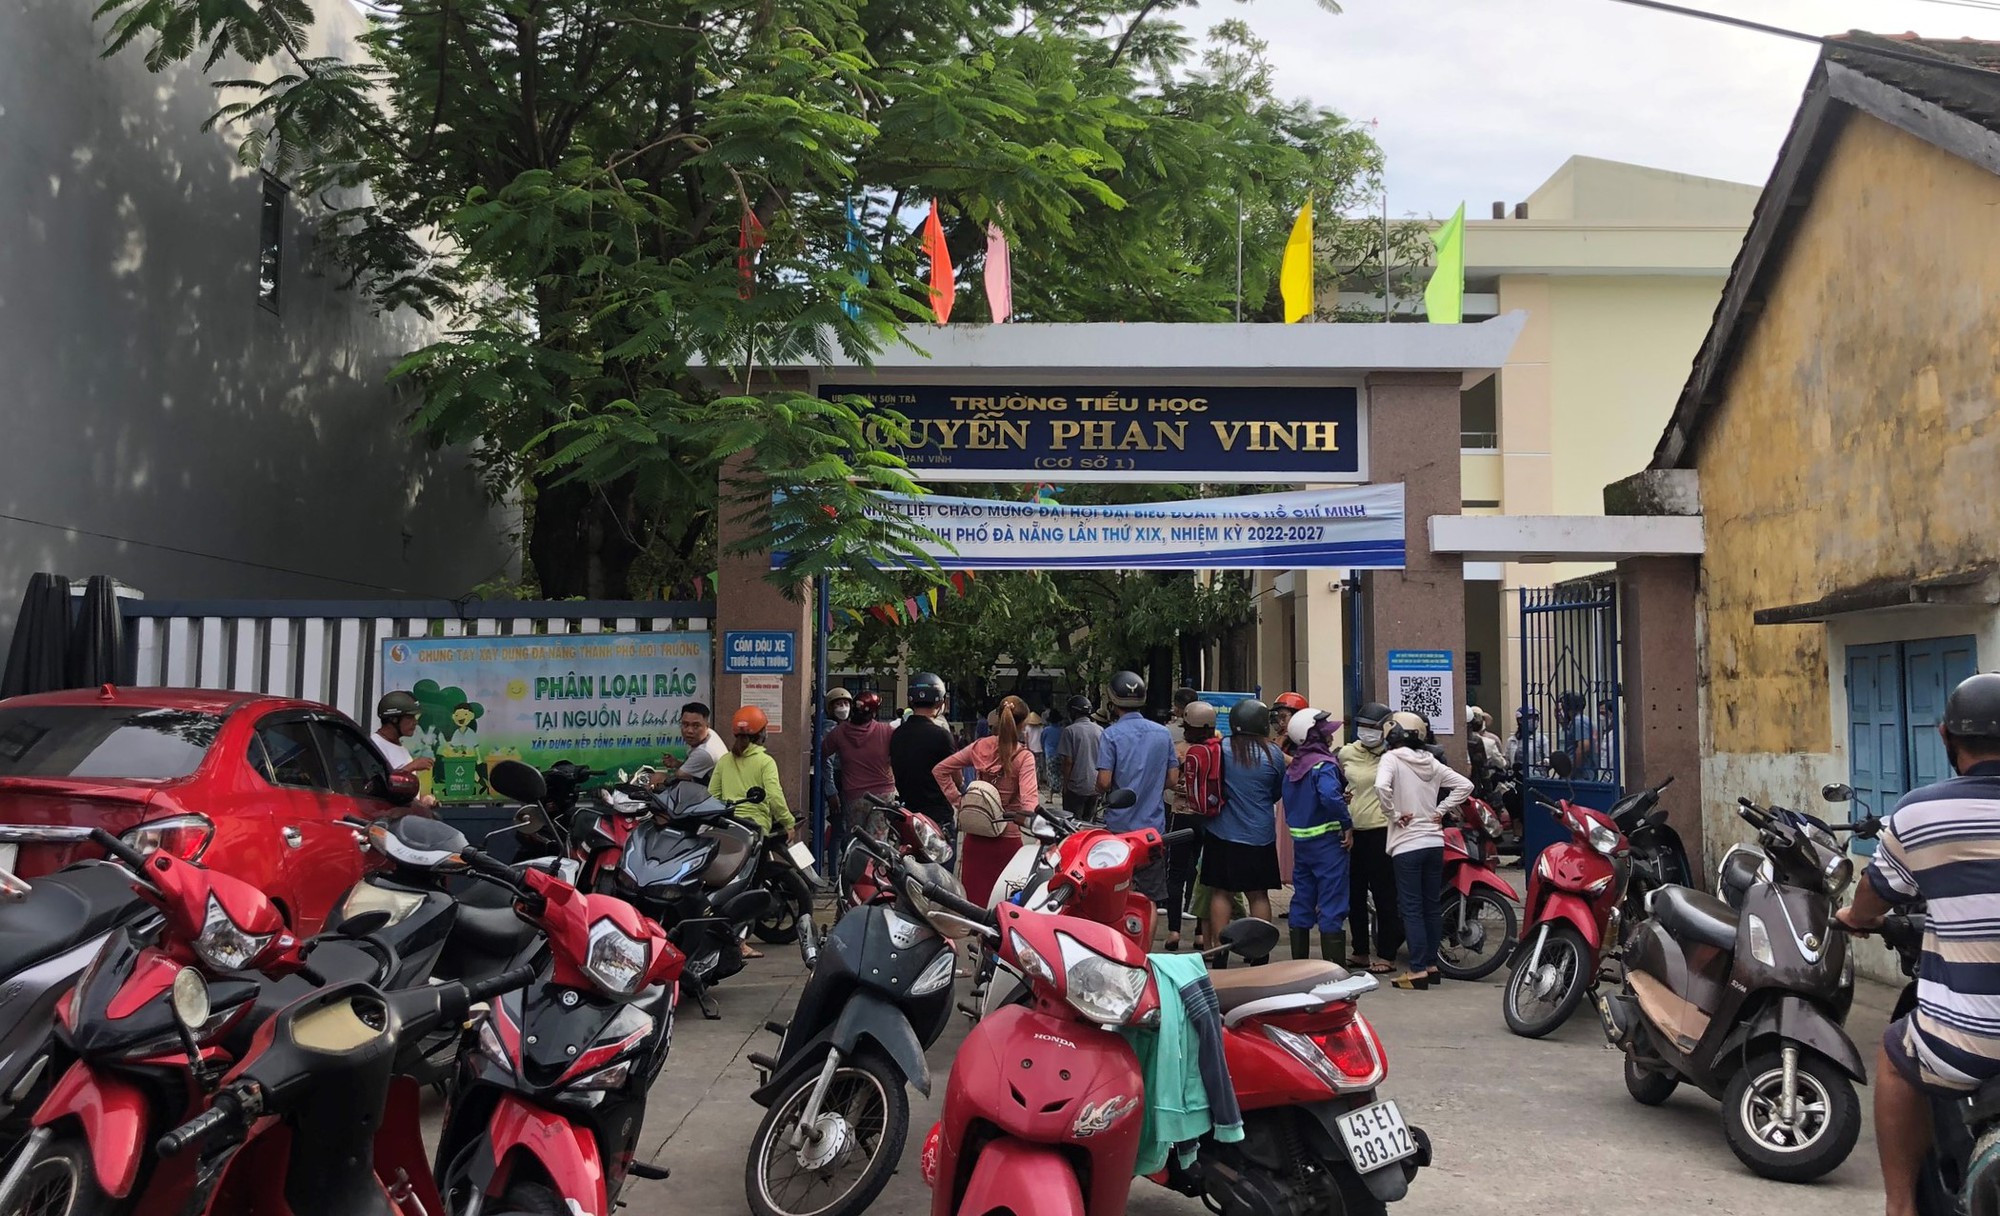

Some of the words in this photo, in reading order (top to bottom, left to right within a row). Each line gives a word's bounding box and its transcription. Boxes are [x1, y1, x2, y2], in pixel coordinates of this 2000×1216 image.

[879, 393, 896, 404] SƠN
[899, 393, 916, 404] TRÀ
[950, 391, 1068, 411] TRƯỜNG
[1076, 391, 1139, 412] TIỂU
[1148, 398, 1209, 416] HỌC
[1049, 420, 1189, 450] PHAN
[1210, 421, 1340, 451] VINH
[898, 455, 924, 464] HAN
[928, 455, 952, 464] VINH
[1034, 456, 1074, 469] (CƠ
[1080, 455, 1108, 469] SỞ
[1115, 457, 1135, 469] 1)
[907, 502, 933, 521] LIỆT
[937, 502, 983, 517] CHÀO
[1039, 507, 1065, 521] ĐẠI
[1292, 504, 1321, 517] CHÍ
[1324, 504, 1366, 517] MINH
[956, 521, 988, 542] PHỐ
[993, 524, 1014, 542] ĐÀ
[1019, 521, 1064, 542] NẴNG
[1069, 521, 1098, 542] LẦN
[1102, 523, 1132, 542] THỨ
[1135, 527, 1166, 545] XIX,
[1171, 524, 1218, 546] NHIỆM
[1224, 521, 1243, 541] KỲ
[1247, 526, 1324, 541] 2022-2027
[734, 635, 753, 652] CẤM
[755, 637, 773, 655] ĐẬU
[775, 640, 786, 652] XE
[418, 649, 453, 663] CHUNG
[457, 649, 475, 662] TAY
[534, 671, 594, 700] PHÂN
[599, 674, 649, 705] LOẠI
[653, 666, 697, 698] RÁC
[535, 710, 558, 732] TẠI
[563, 703, 621, 728] NGUỒN
[532, 737, 547, 750] XÂY
[549, 737, 572, 750] DỰNG
[575, 734, 591, 749] NẾP
[593, 733, 615, 748] SỐNG
[616, 735, 633, 748] VĂN
[656, 733, 673, 747] VĂN
[1731, 980, 1747, 993] SYM
[1033, 1033, 1077, 1049] HONDA
[1348, 1104, 1395, 1139] 43-E1
[1353, 1127, 1412, 1168] 383.12
